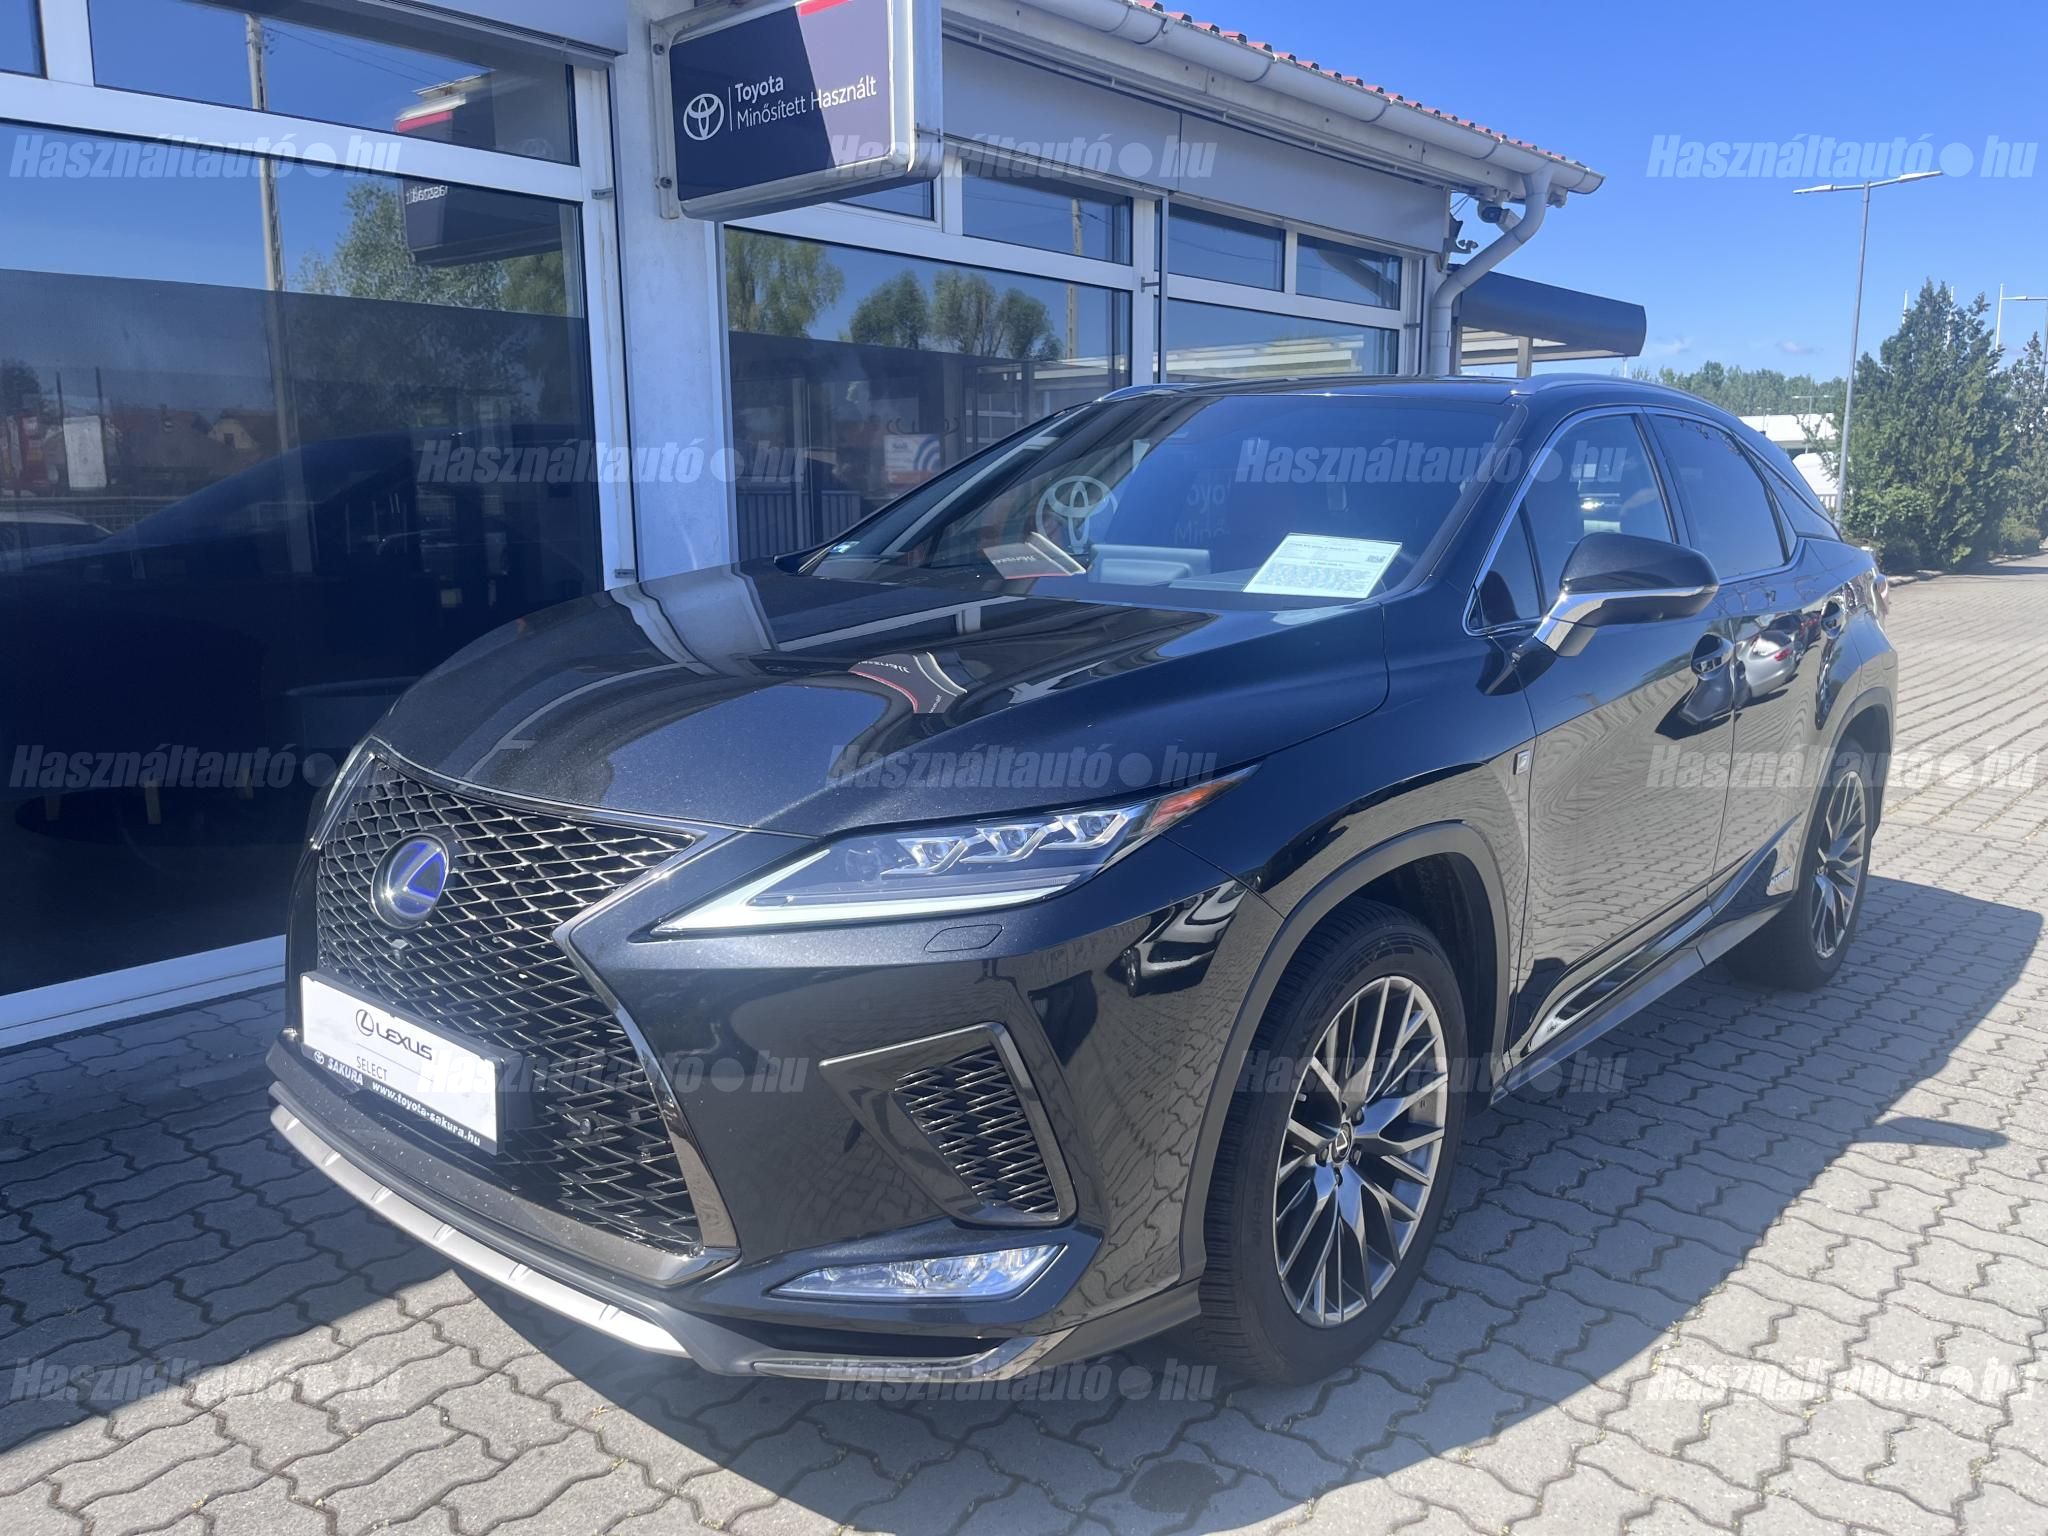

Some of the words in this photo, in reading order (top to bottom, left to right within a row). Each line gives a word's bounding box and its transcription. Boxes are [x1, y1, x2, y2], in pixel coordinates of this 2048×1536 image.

[735, 75, 784, 104] Toyota
[737, 92, 807, 130] Minősített
[811, 74, 878, 111] Használt
[376, 1022, 433, 1060] LEXUS
[327, 1058, 364, 1086] SAKURA
[356, 1056, 388, 1081] SELECT
